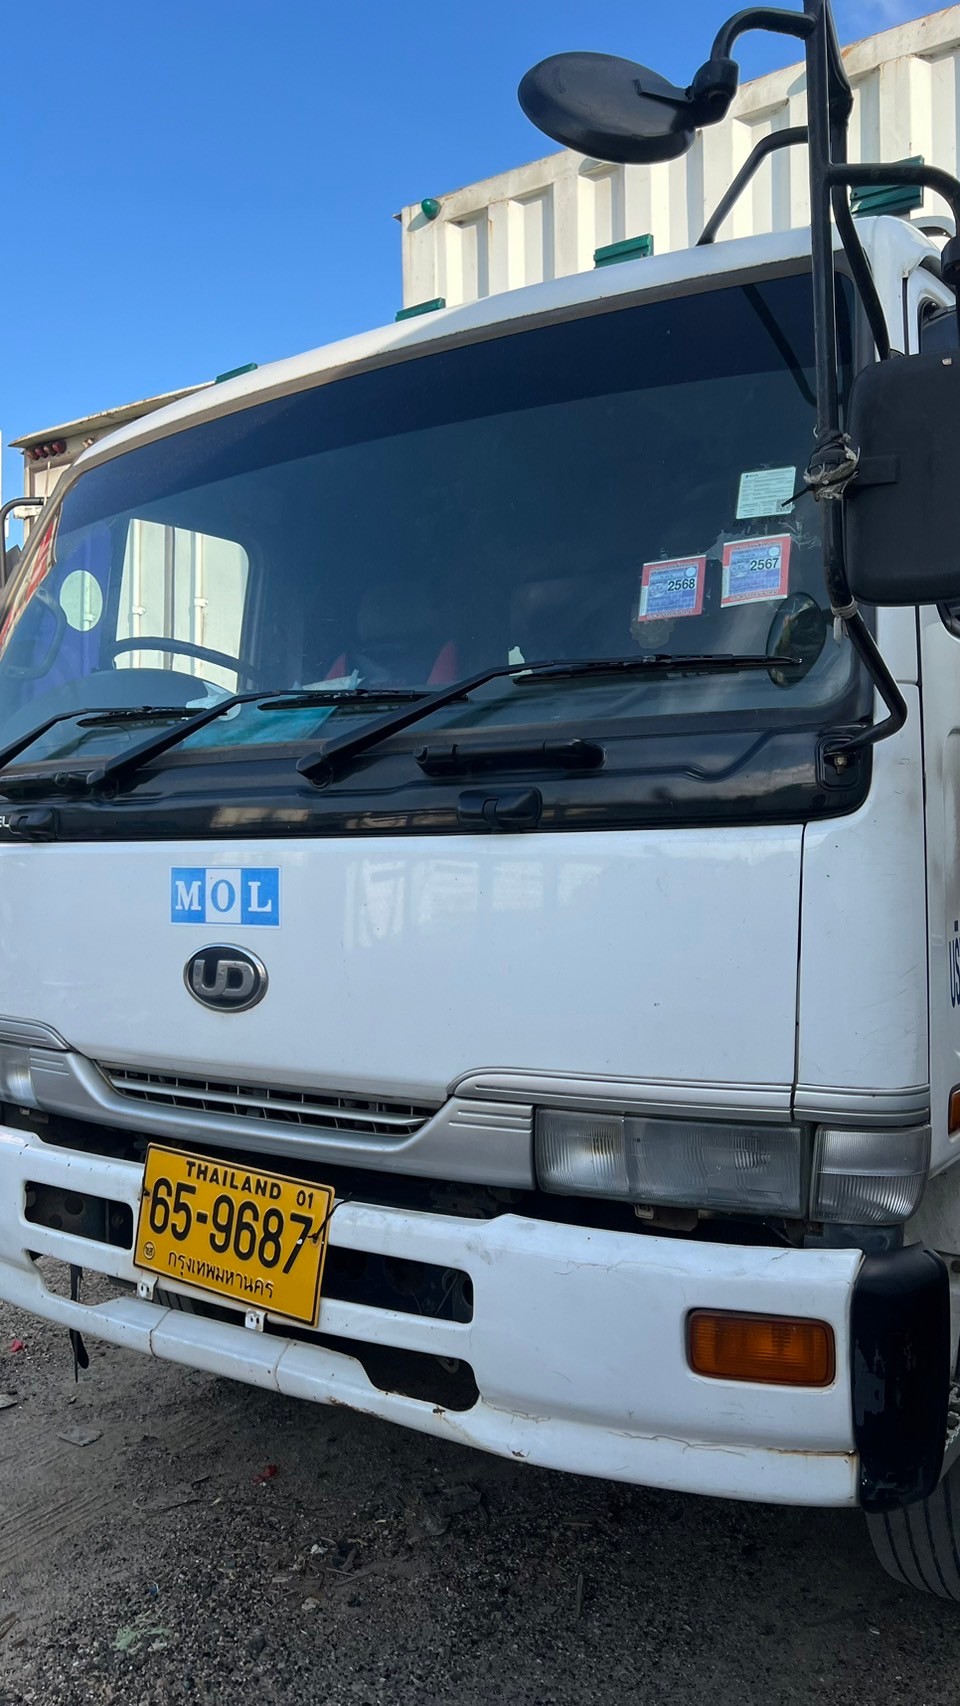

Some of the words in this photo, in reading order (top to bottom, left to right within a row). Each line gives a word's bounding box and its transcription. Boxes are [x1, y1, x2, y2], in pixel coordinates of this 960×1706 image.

[750, 557, 779, 571] 2567
[667, 578, 695, 592] 2568
[175, 879, 272, 913] MOL
[192, 959, 255, 997] UD
[186, 1160, 281, 1200] THAILAND
[296, 1189, 314, 1209] 01
[149, 1177, 314, 1275] 65-9687
[168, 1251, 275, 1299] กรุงเทพมหานคร
